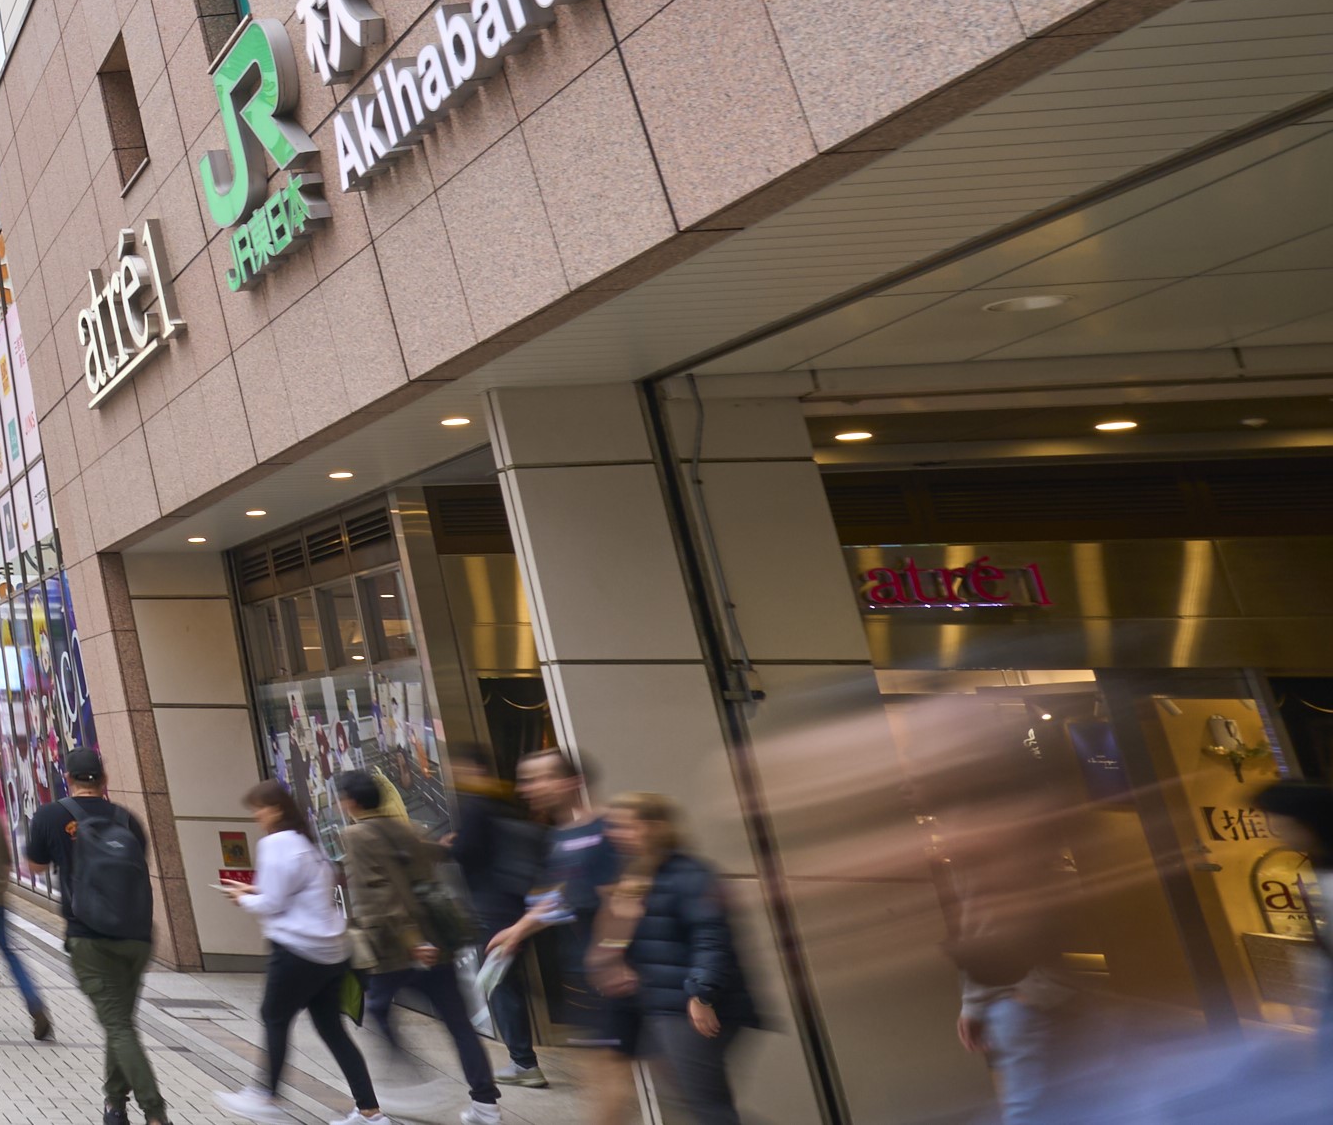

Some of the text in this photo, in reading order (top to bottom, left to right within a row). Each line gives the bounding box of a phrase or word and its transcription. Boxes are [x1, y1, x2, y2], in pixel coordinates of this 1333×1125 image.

[199, 18, 313, 228] JR
[226, 173, 318, 292] JR東日本
[864, 555, 1012, 606] atré
